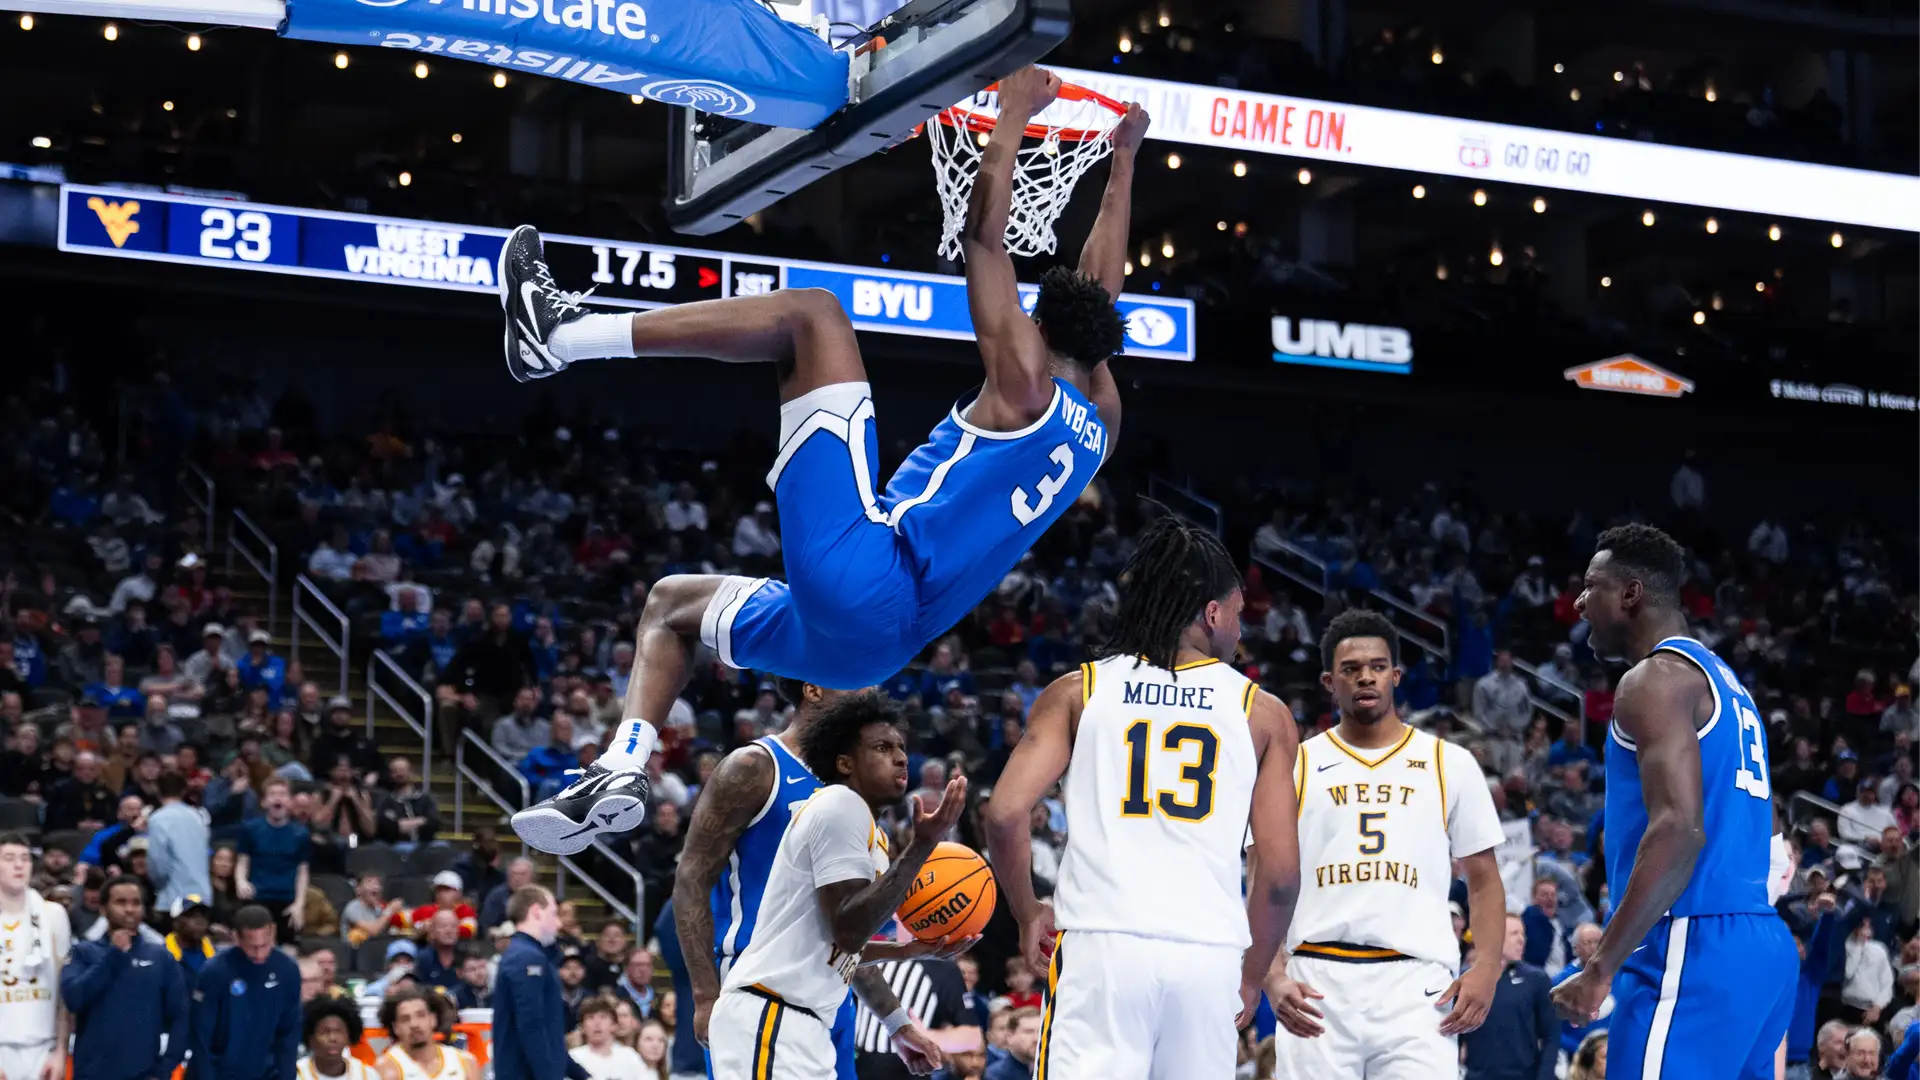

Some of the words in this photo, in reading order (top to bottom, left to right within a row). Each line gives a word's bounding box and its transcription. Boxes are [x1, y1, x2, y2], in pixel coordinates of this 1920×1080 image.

[428, 0, 648, 39] state
[380, 32, 647, 84] Allstate
[1211, 97, 1297, 146] GAME
[1305, 109, 1353, 153] ON.
[1504, 143, 1529, 168] GO
[1535, 147, 1560, 172] GO
[1566, 150, 1591, 176] GO
[200, 209, 271, 263] 23
[376, 224, 465, 258] WEST
[344, 244, 494, 286] VIRGINIA
[592, 246, 676, 290] 17.5
[735, 271, 776, 296] 1ST
[852, 278, 933, 322] BYU
[1271, 315, 1413, 364] UMB
[1011, 443, 1074, 527] 3
[1123, 681, 1214, 710] MOORE
[1733, 696, 1770, 800] 13
[1120, 719, 1221, 823] 13
[1326, 783, 1415, 806] WEST
[1357, 811, 1388, 856] 5
[1315, 860, 1419, 889] VIRGINIA
[910, 892, 972, 933] Wilson
